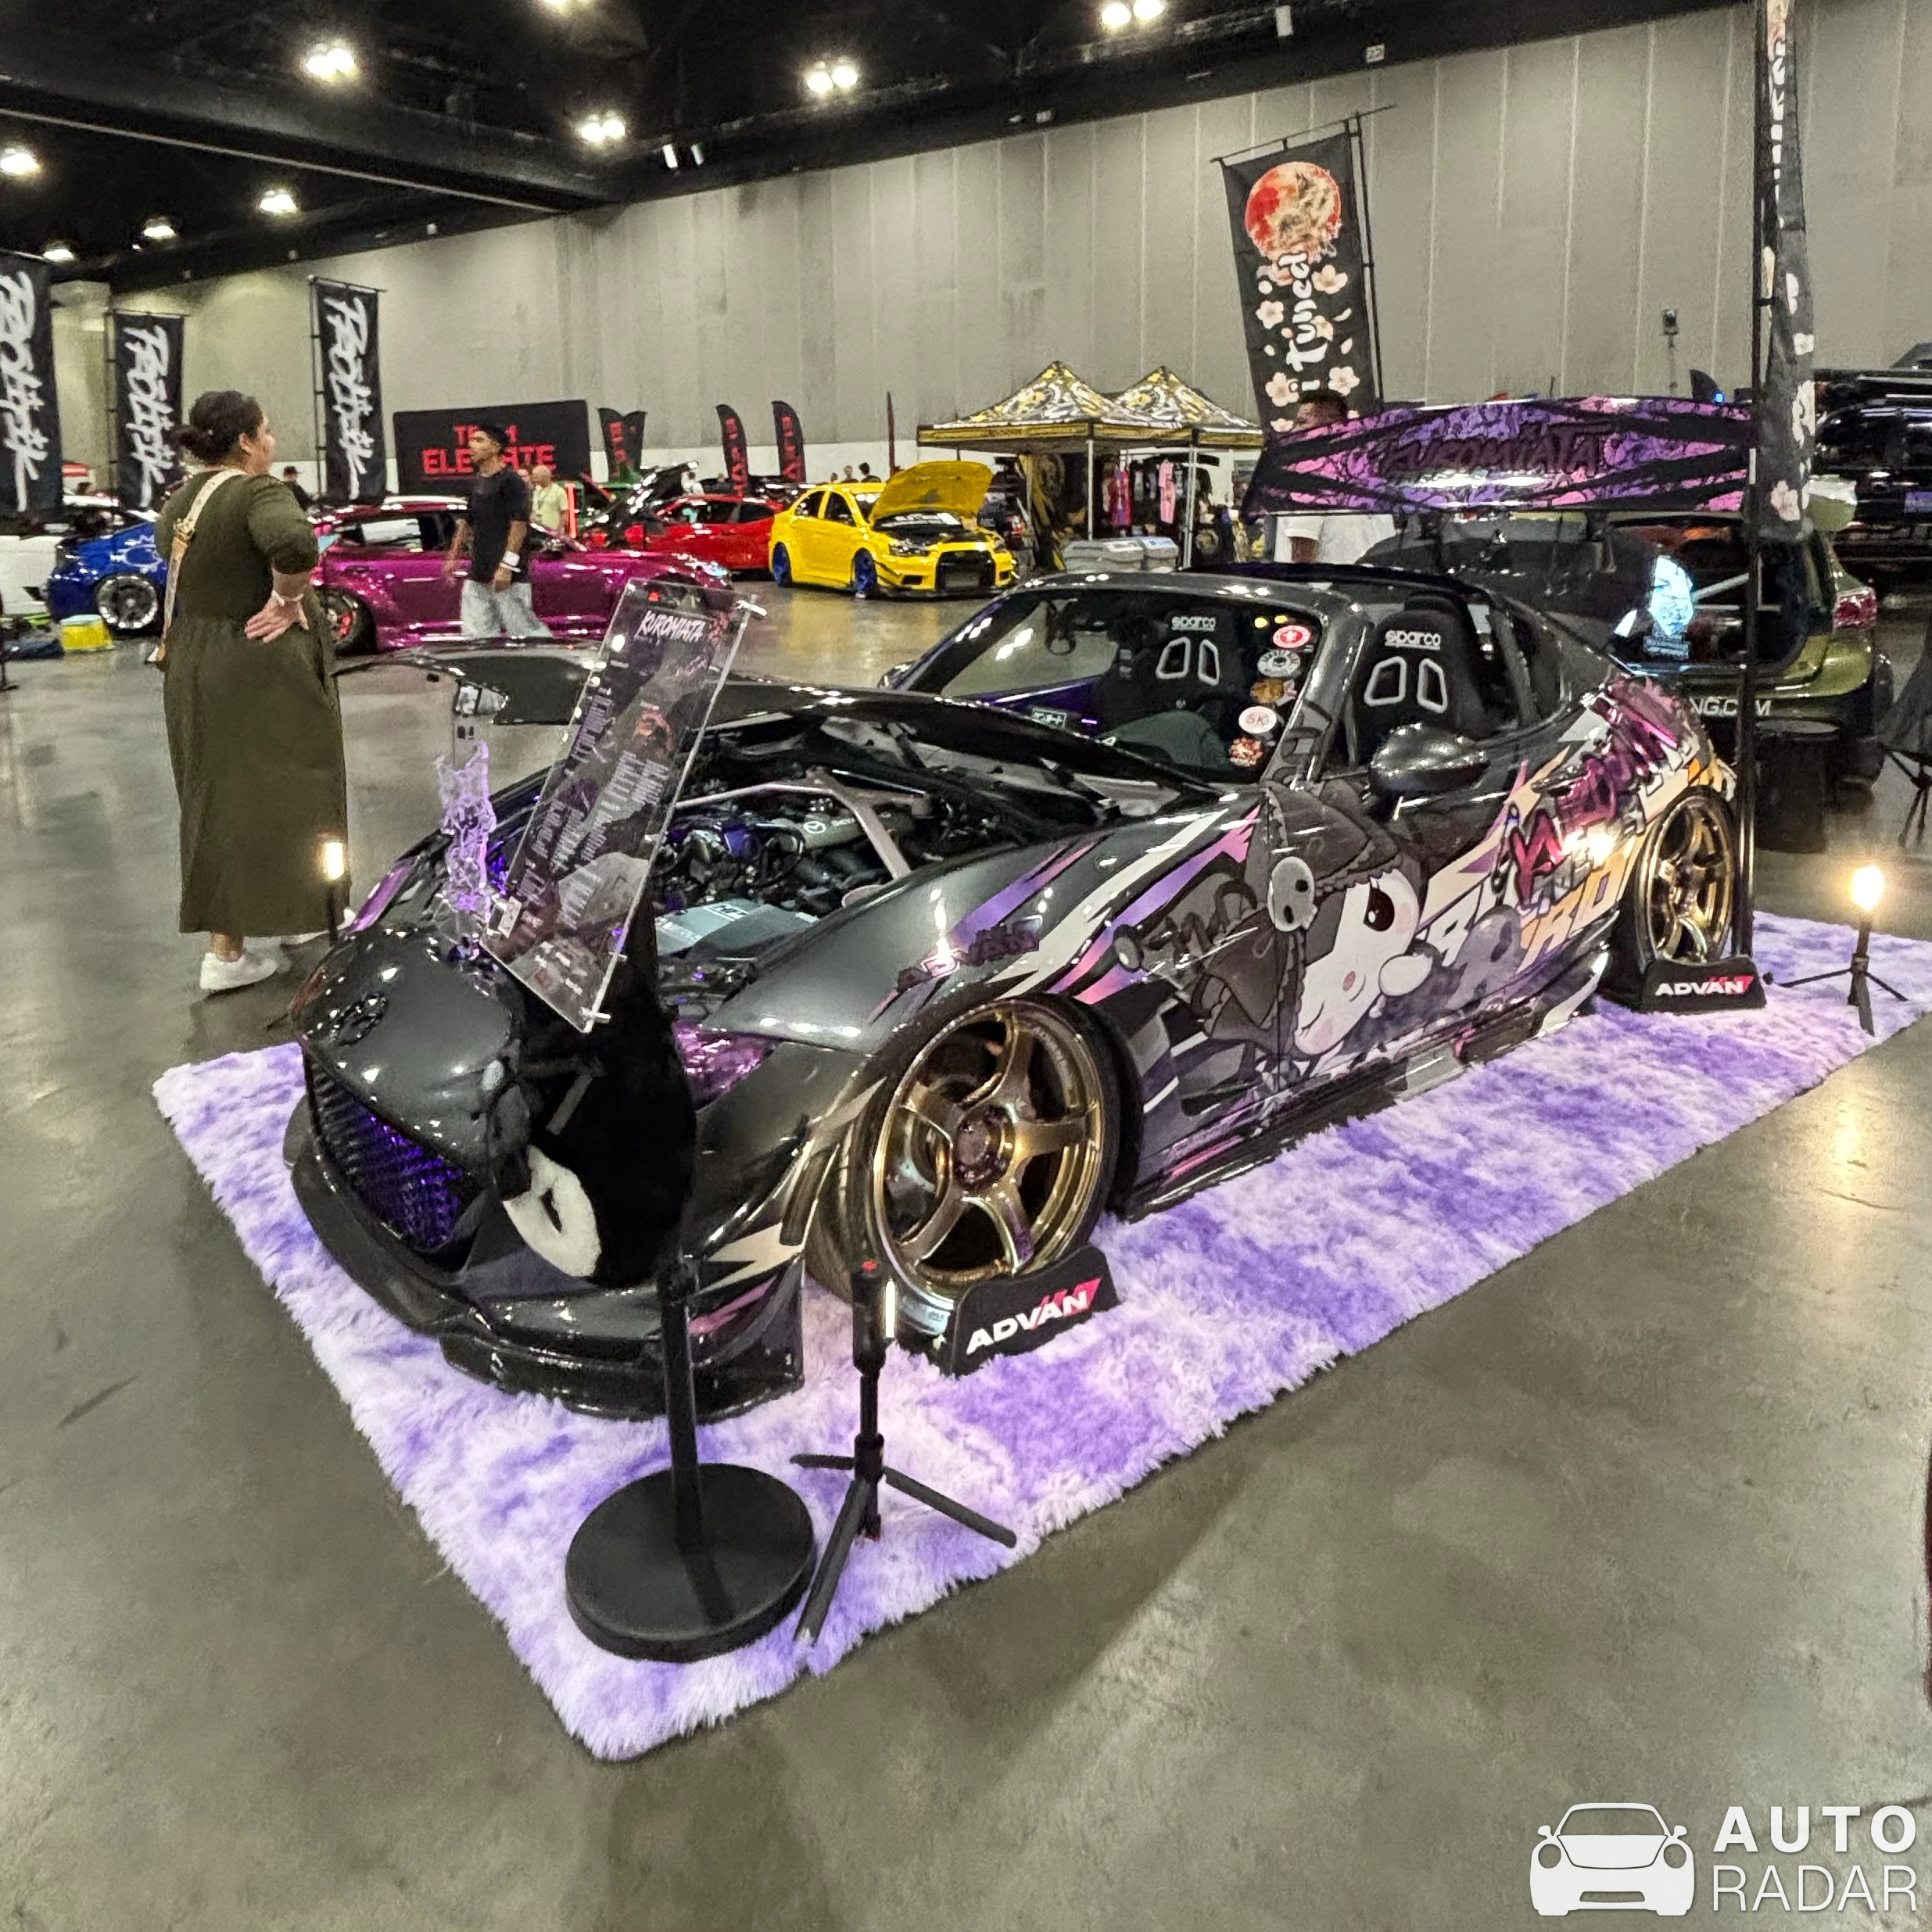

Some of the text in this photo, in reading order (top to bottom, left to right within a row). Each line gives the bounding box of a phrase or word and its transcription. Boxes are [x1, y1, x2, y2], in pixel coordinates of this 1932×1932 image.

[422, 444, 556, 475] ELEATE
[1172, 616, 1216, 632] sparco
[1385, 630, 1441, 651] sparco
[1654, 980, 1745, 996] ADVAN
[966, 1291, 1088, 1354] ADVAN
